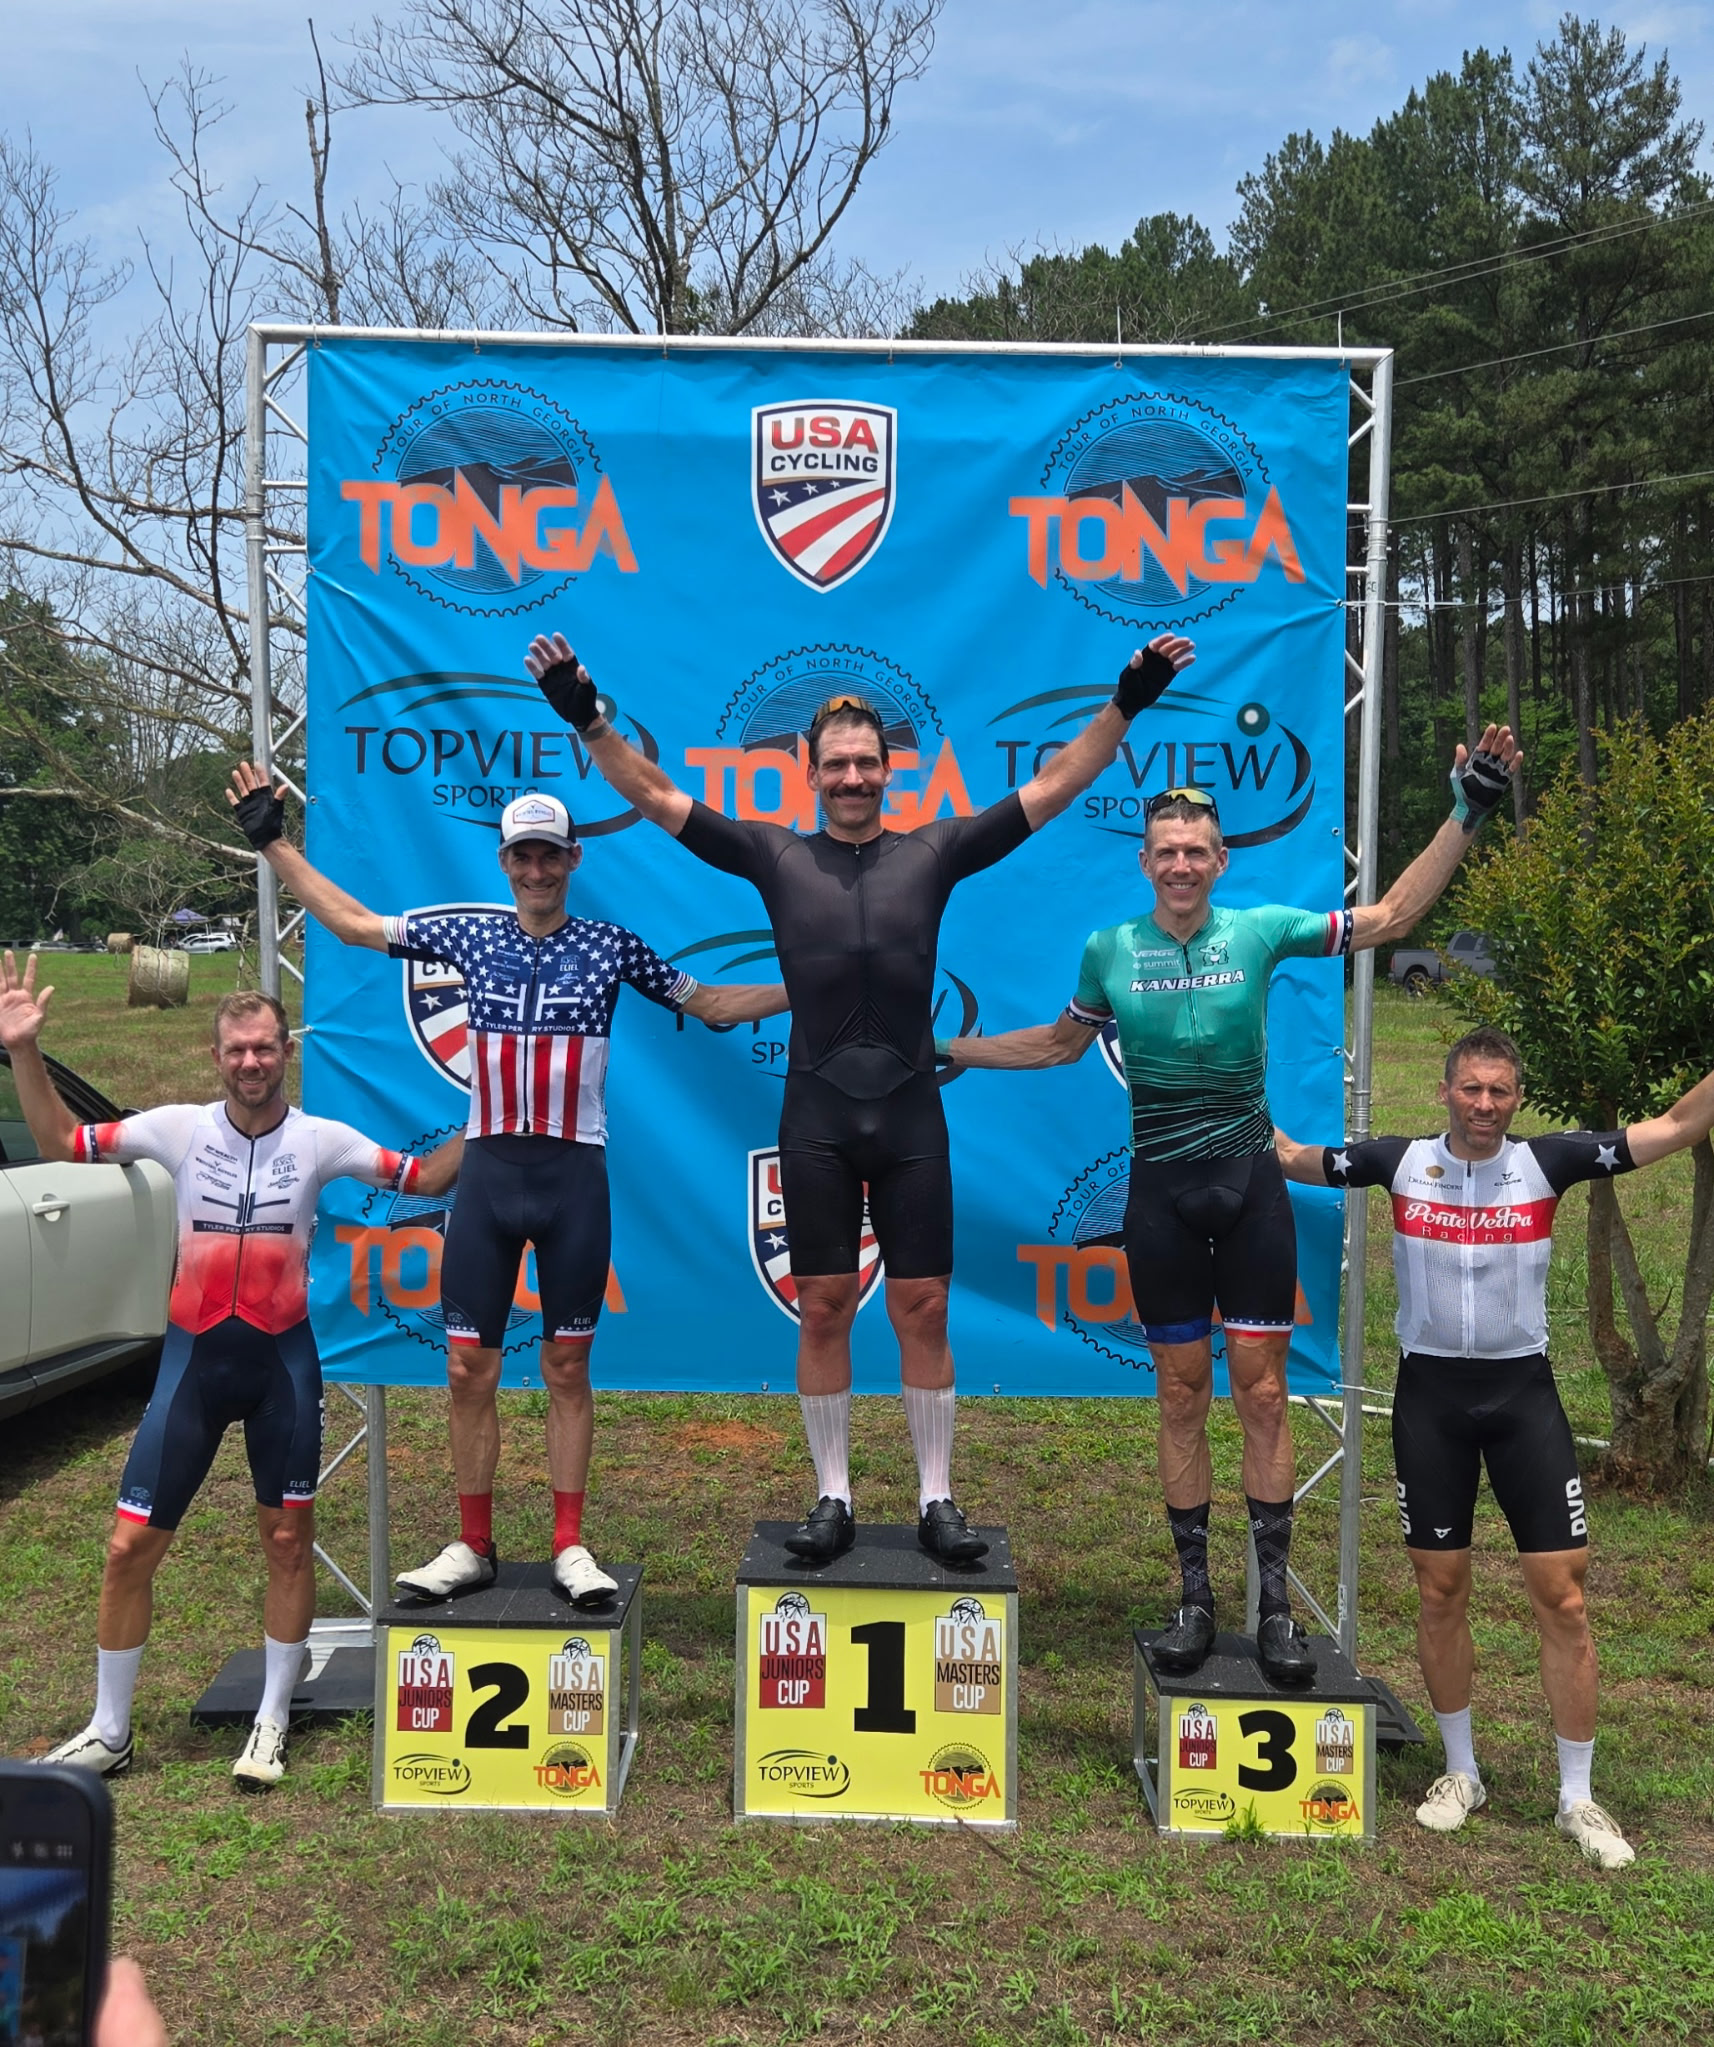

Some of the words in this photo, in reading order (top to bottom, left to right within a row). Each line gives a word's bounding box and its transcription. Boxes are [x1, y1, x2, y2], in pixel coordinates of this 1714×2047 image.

[391, 417, 425, 457] TOUR
[431, 400, 451, 416] OF
[464, 393, 522, 408] NORTH
[533, 407, 585, 466] GEORGIA
[771, 416, 879, 454] USA
[1058, 432, 1092, 471] TOUR
[1099, 414, 1120, 430] OF
[1131, 405, 1189, 420] NORTH
[1200, 420, 1255, 478] GEORGIA
[770, 453, 879, 473] CYCLING
[340, 473, 640, 586] TONGA
[1009, 484, 1306, 598] TONGA
[734, 684, 768, 723] TOUR
[775, 666, 794, 681] OF
[807, 658, 864, 673] NORTH
[875, 671, 927, 730] GEORGIA
[1131, 949, 1176, 958] VERGE
[1143, 959, 1181, 968] summit
[559, 964, 579, 972] ELIEL
[1130, 969, 1245, 992] KANBERRA
[486, 1022, 507, 1030] TYLER
[272, 1164, 298, 1176] ELIEL
[1066, 1183, 1100, 1219] TOUR
[1107, 1161, 1126, 1178] OF
[202, 1223, 224, 1231] TYLER
[1404, 1203, 1467, 1229] Ponte
[1470, 1207, 1534, 1229] Vedra
[1422, 1226, 1513, 1243] Racing
[573, 1317, 592, 1325] ELIEL
[289, 1480, 311, 1488] ELIEL
[765, 1620, 822, 1656] USA
[940, 1624, 998, 1662] USA
[403, 1658, 450, 1687] USA
[554, 1661, 601, 1691] USA
[761, 1658, 825, 1680] JUNIORS
[850, 1620, 917, 1734] 1
[937, 1661, 1000, 1685] MASTERS
[399, 1689, 452, 1708] JUNIORS
[550, 1692, 603, 1711] MASTERS
[777, 1680, 810, 1705] CUP
[953, 1684, 985, 1710] CUP
[464, 1662, 530, 1749] 2
[412, 1708, 440, 1729] CUP
[563, 1711, 591, 1732] CUP
[1182, 1719, 1215, 1740] USA
[1319, 1724, 1351, 1745] USA
[1189, 1752, 1208, 1767] CUP
[1238, 1709, 1297, 1792] 3
[1317, 1744, 1353, 1759] MASTERS
[393, 1767, 463, 1781] TOPVIEW
[758, 1766, 841, 1782] TOPVIEW
[1326, 1758, 1345, 1772] CUP
[533, 1764, 602, 1790] TONGA
[919, 1767, 1002, 1801] TONGA
[1173, 1798, 1229, 1811] TOPVIEW
[1299, 1798, 1361, 1823] TONGA
